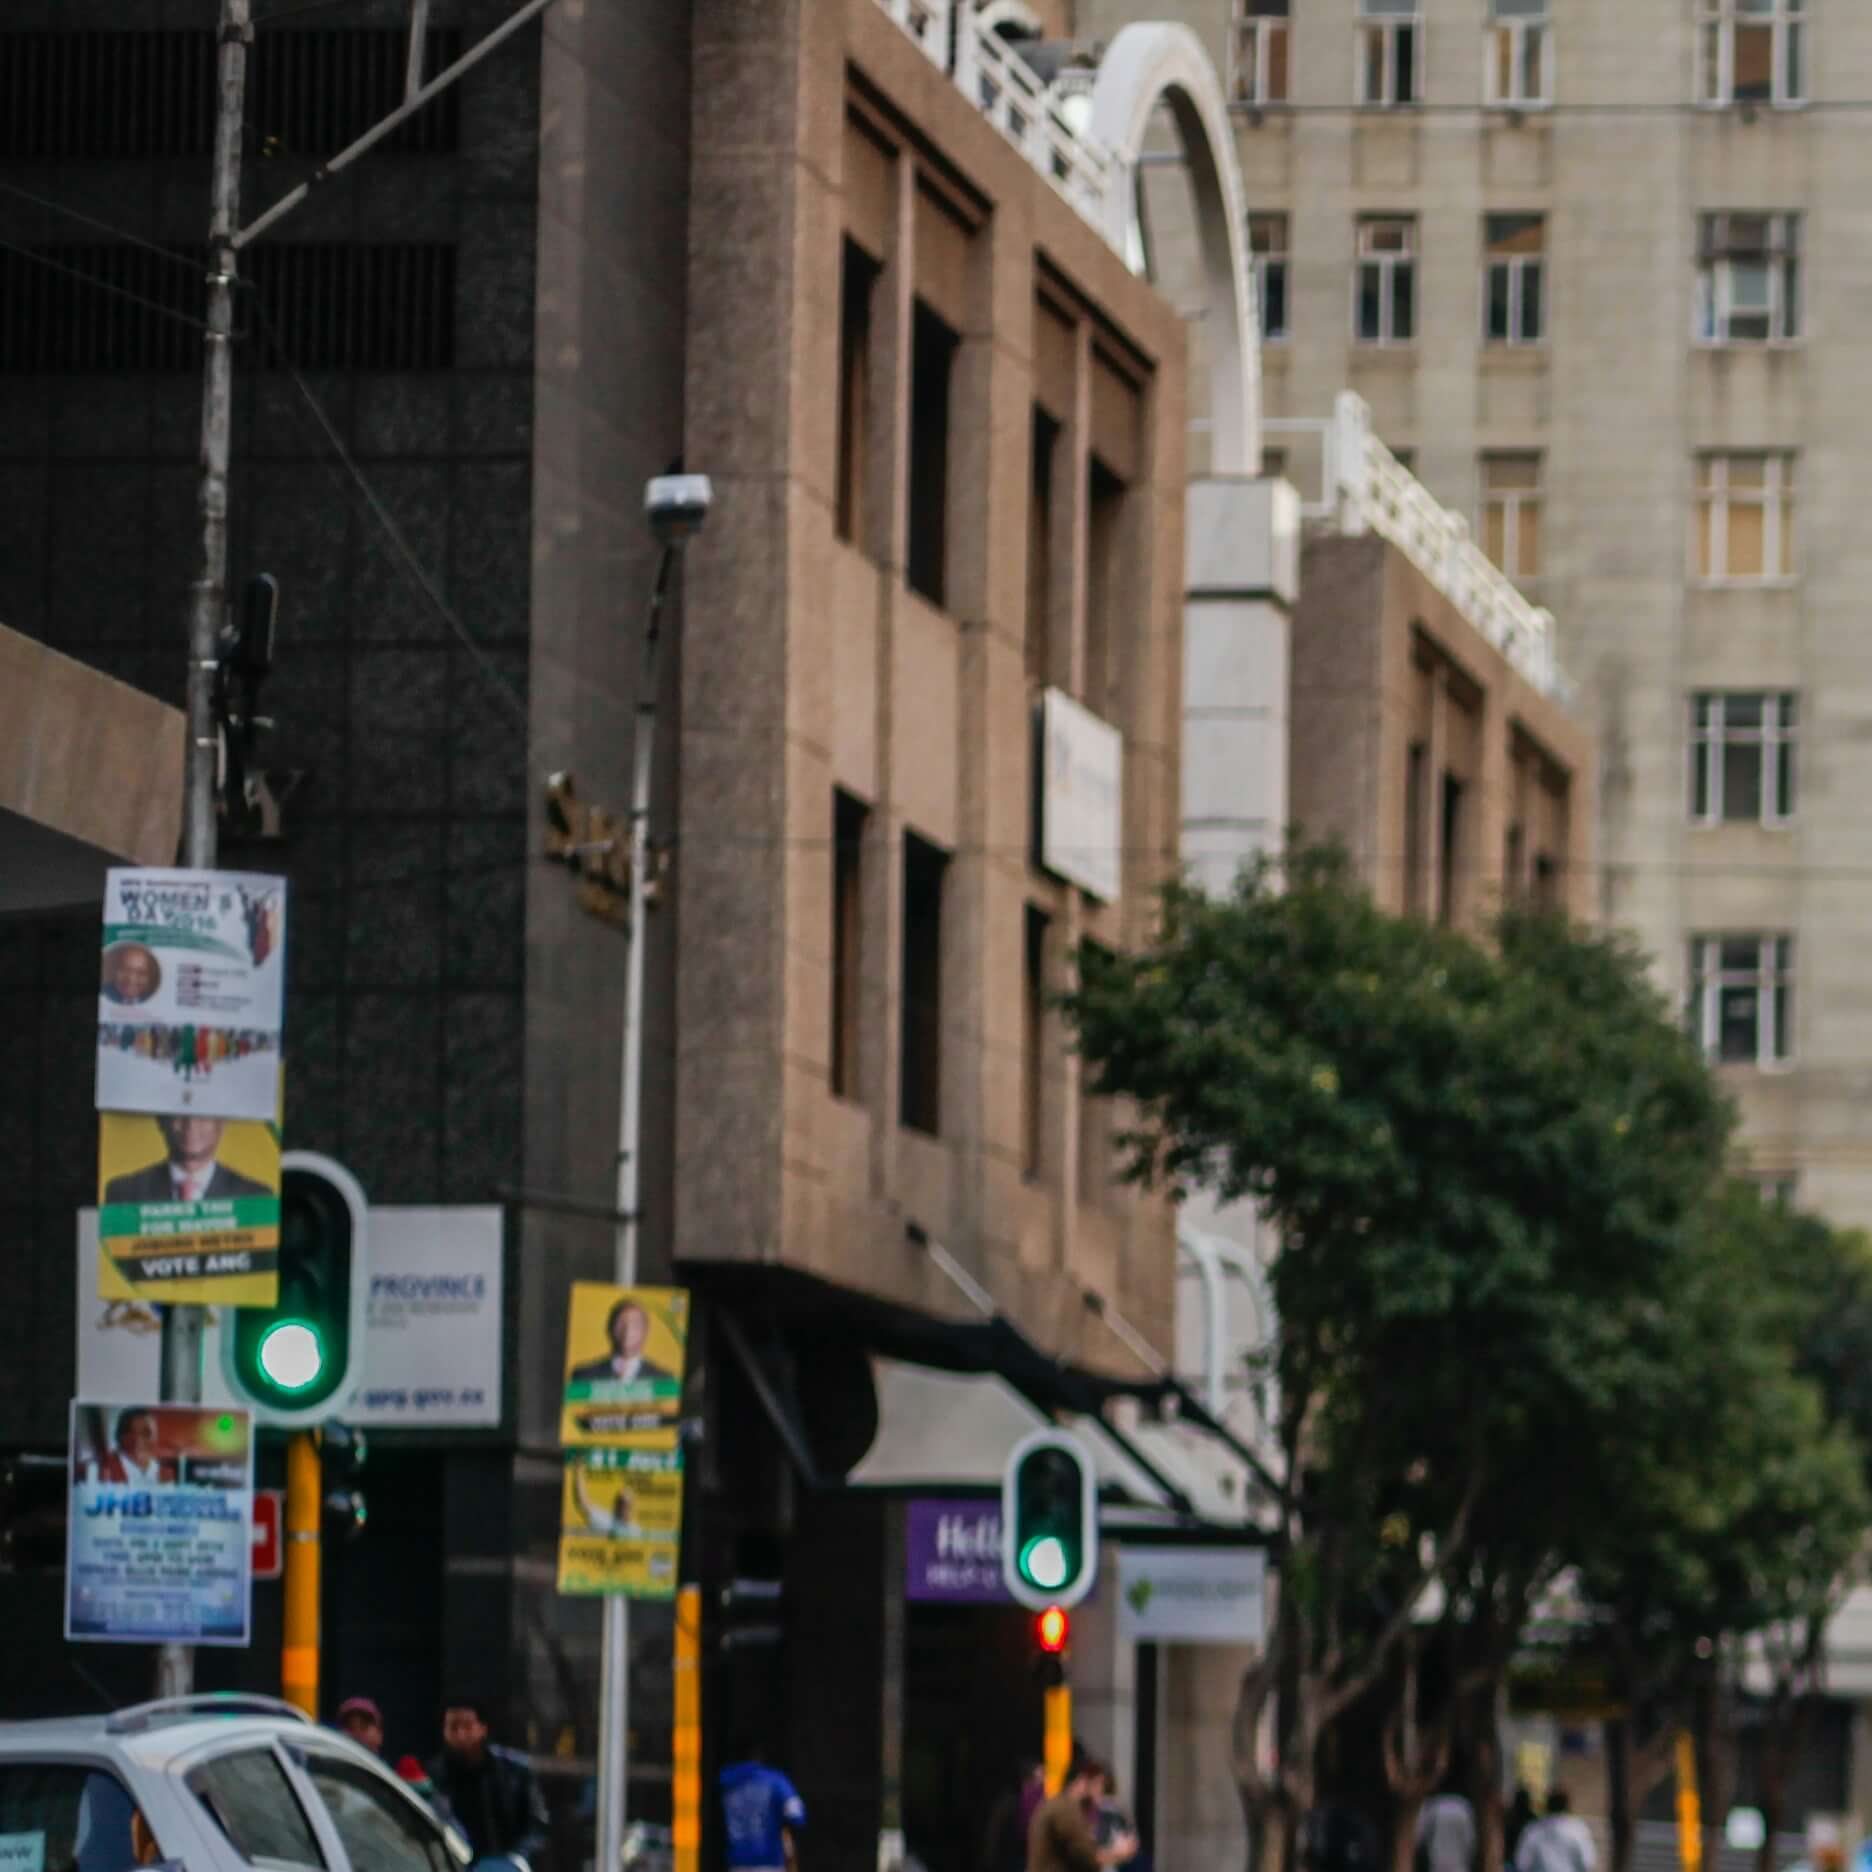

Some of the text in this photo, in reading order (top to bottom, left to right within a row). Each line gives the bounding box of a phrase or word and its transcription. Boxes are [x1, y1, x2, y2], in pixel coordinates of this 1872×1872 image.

[140, 1255, 199, 1277] VOTE
[370, 1274, 486, 1299] PROVINCE
[85, 1492, 153, 1517] JHB
